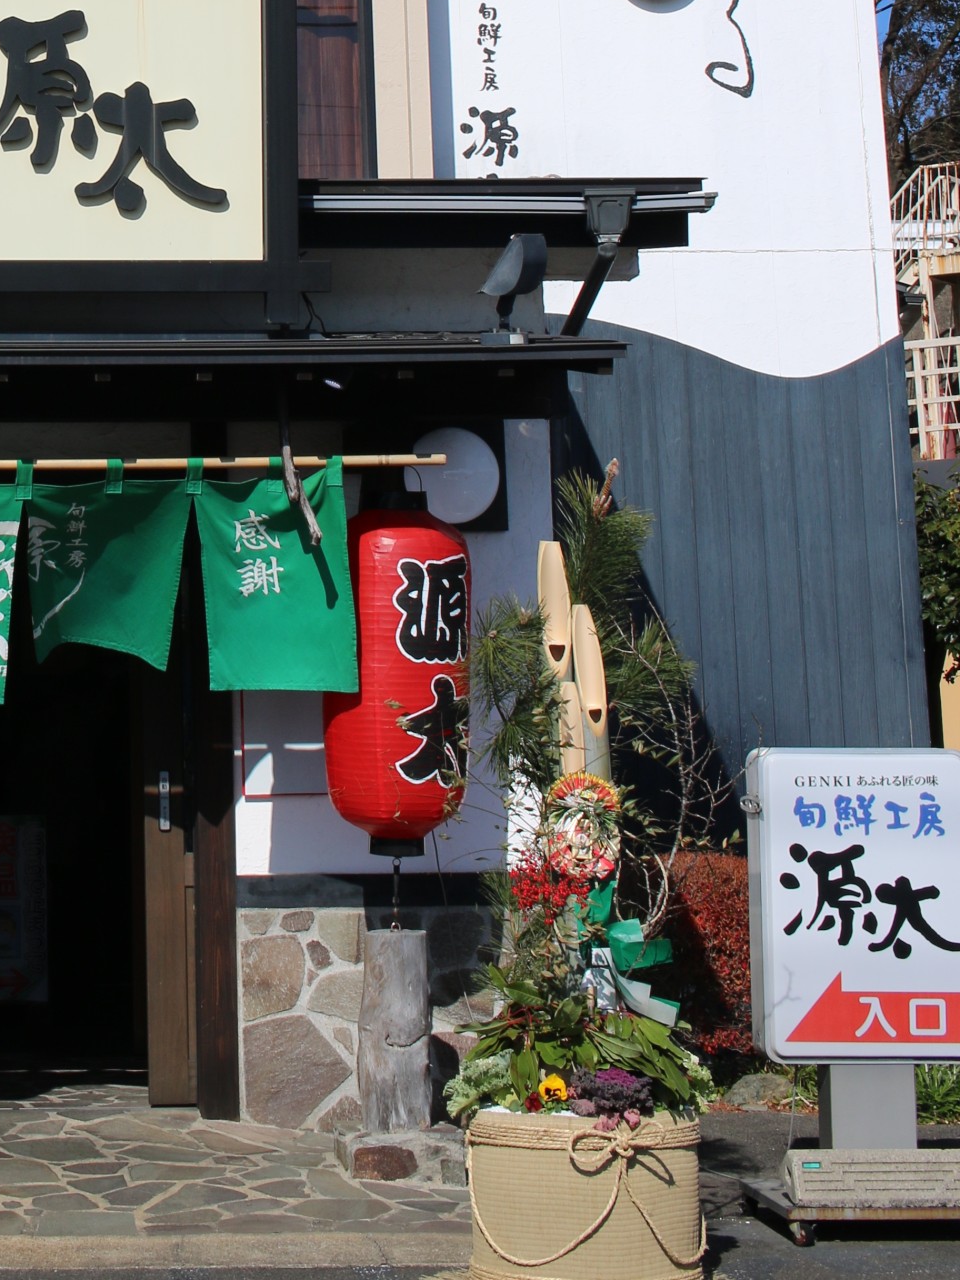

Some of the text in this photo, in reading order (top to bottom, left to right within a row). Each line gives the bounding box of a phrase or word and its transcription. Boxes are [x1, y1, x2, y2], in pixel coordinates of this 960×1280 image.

[460, 2, 519, 179] 旬鮮工房 源
[65, 502, 89, 569] 旬鮮工房
[234, 507, 283, 600] 感謝
[793, 792, 945, 838] 旬鮮工房
[780, 843, 960, 960] 源太
[855, 996, 946, 1038] 入口
